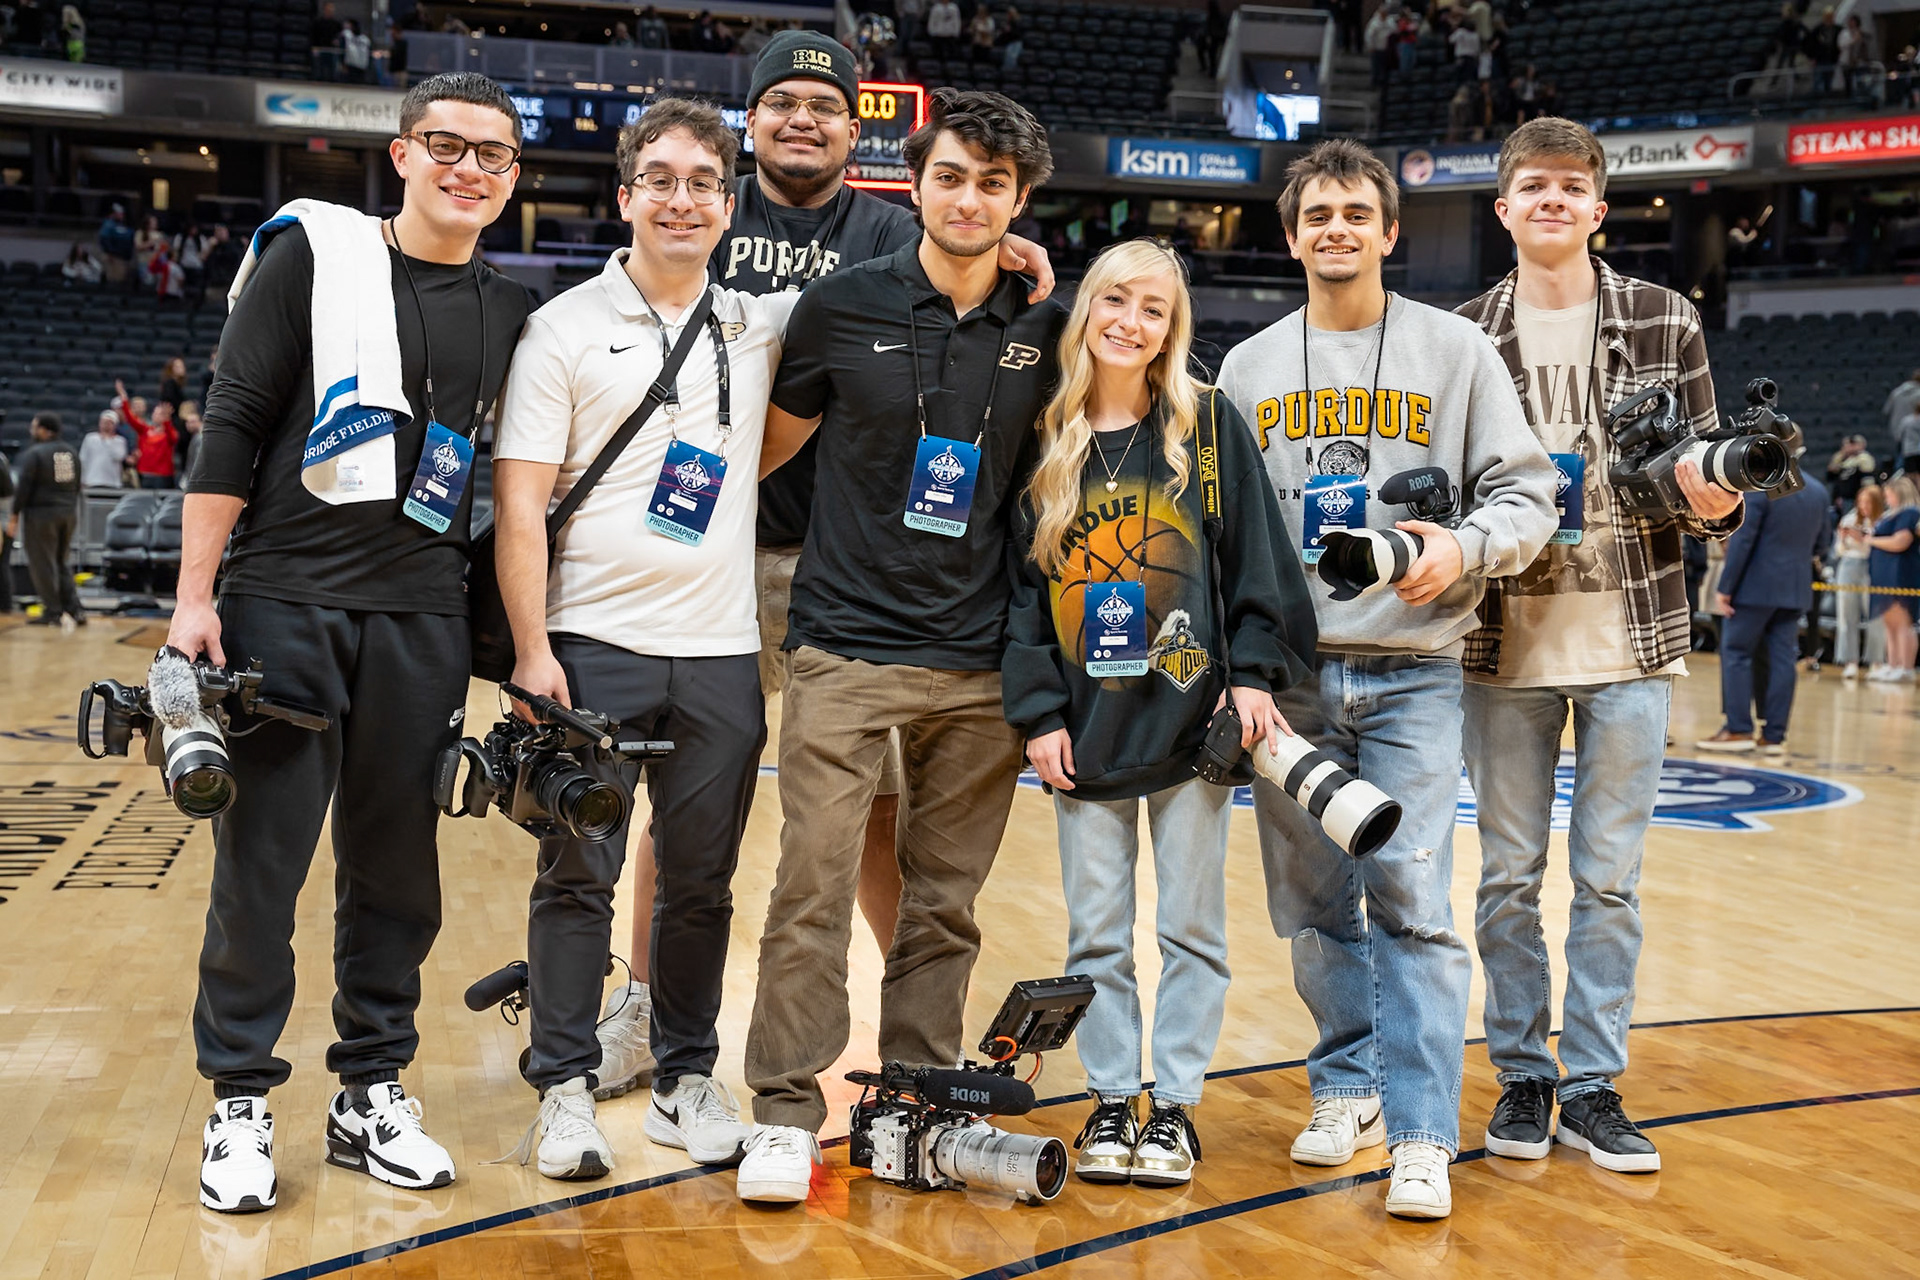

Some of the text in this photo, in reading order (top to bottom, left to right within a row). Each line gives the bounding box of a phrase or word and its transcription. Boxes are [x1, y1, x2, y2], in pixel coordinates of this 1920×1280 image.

[7, 71, 54, 86] CITY
[65, 75, 118, 93] WIDE
[793, 63, 836, 76] NETWORK
[331, 98, 400, 119] Kineti
[1792, 129, 1866, 156] STEAK
[1885, 125, 1920, 149] SH
[1121, 139, 1190, 176] ksm
[1606, 142, 1688, 169] eyBank
[1000, 342, 1041, 371] P
[1256, 386, 1432, 453] PURDUE
[1201, 446, 1216, 482] D500
[1408, 474, 1435, 491] RØDE
[1787, 470, 1798, 487] SONY
[1207, 485, 1215, 513] Nikon
[408, 501, 446, 527] PHOTOGRAPHER
[910, 514, 961, 532] PHOTOGRAPHER
[648, 515, 699, 541] PHOTOGRAPHER
[1092, 662, 1143, 672] PHOTOGRAPHER
[1158, 650, 1207, 682] PURDUE
[950, 1086, 990, 1105] RØDE
[1008, 1151, 1020, 1161] 20
